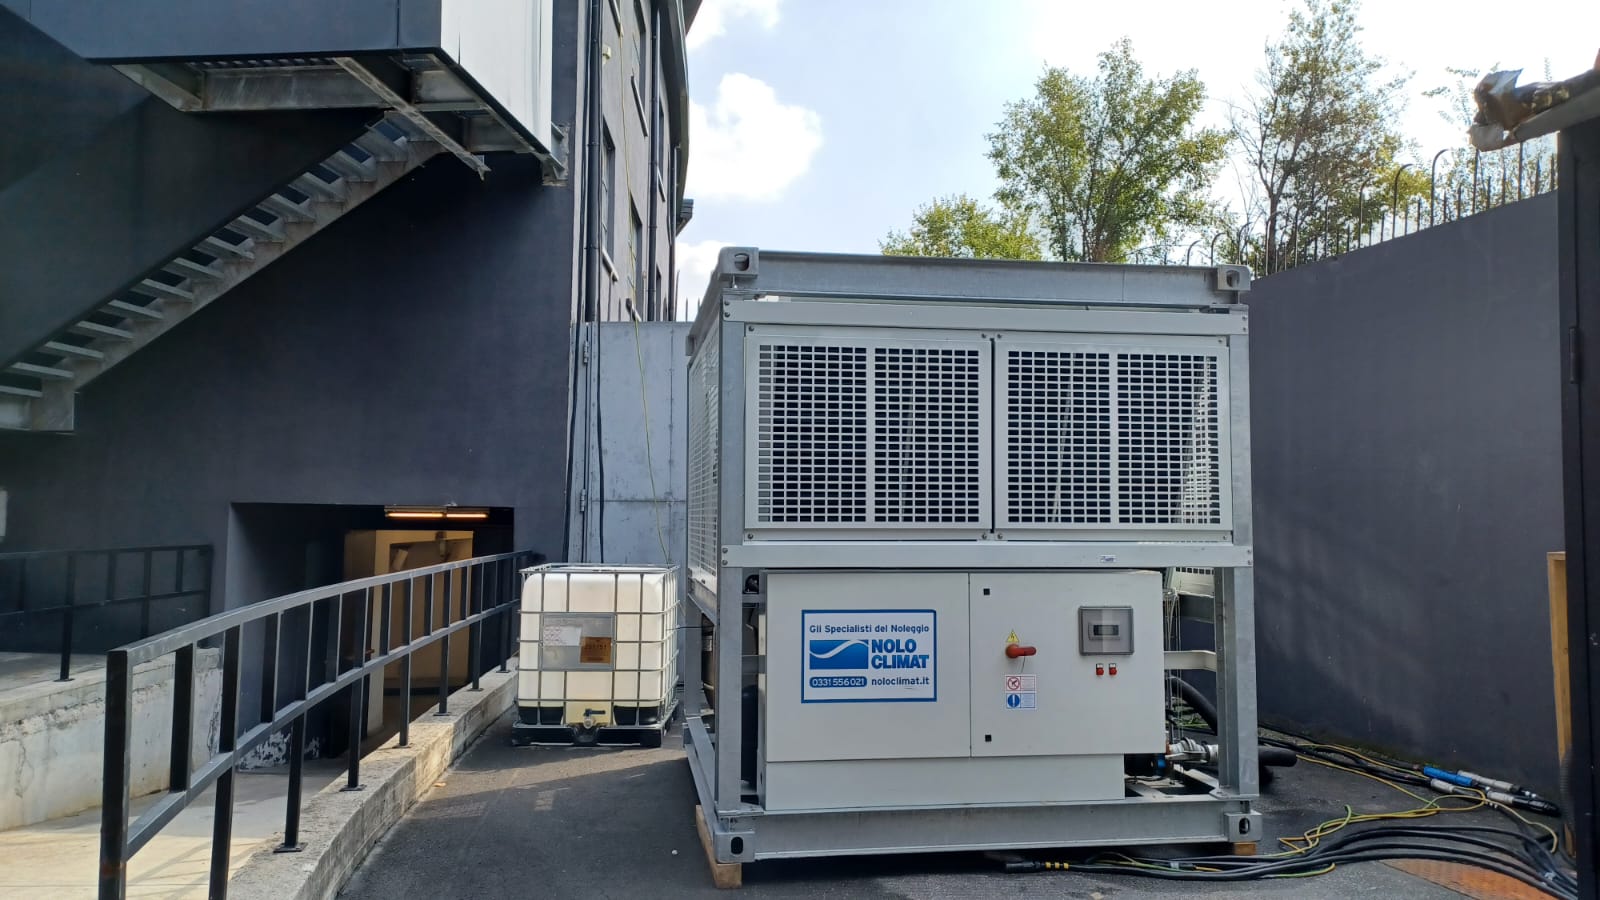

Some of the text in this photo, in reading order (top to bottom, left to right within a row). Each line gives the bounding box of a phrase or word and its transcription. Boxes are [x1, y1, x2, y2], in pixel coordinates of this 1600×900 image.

[809, 624, 930, 634] Gli Specialisti del Noleggio
[871, 638, 917, 653] NOLO
[871, 654, 930, 669] CLIMAT
[871, 676, 930, 686] noloclimat.it
